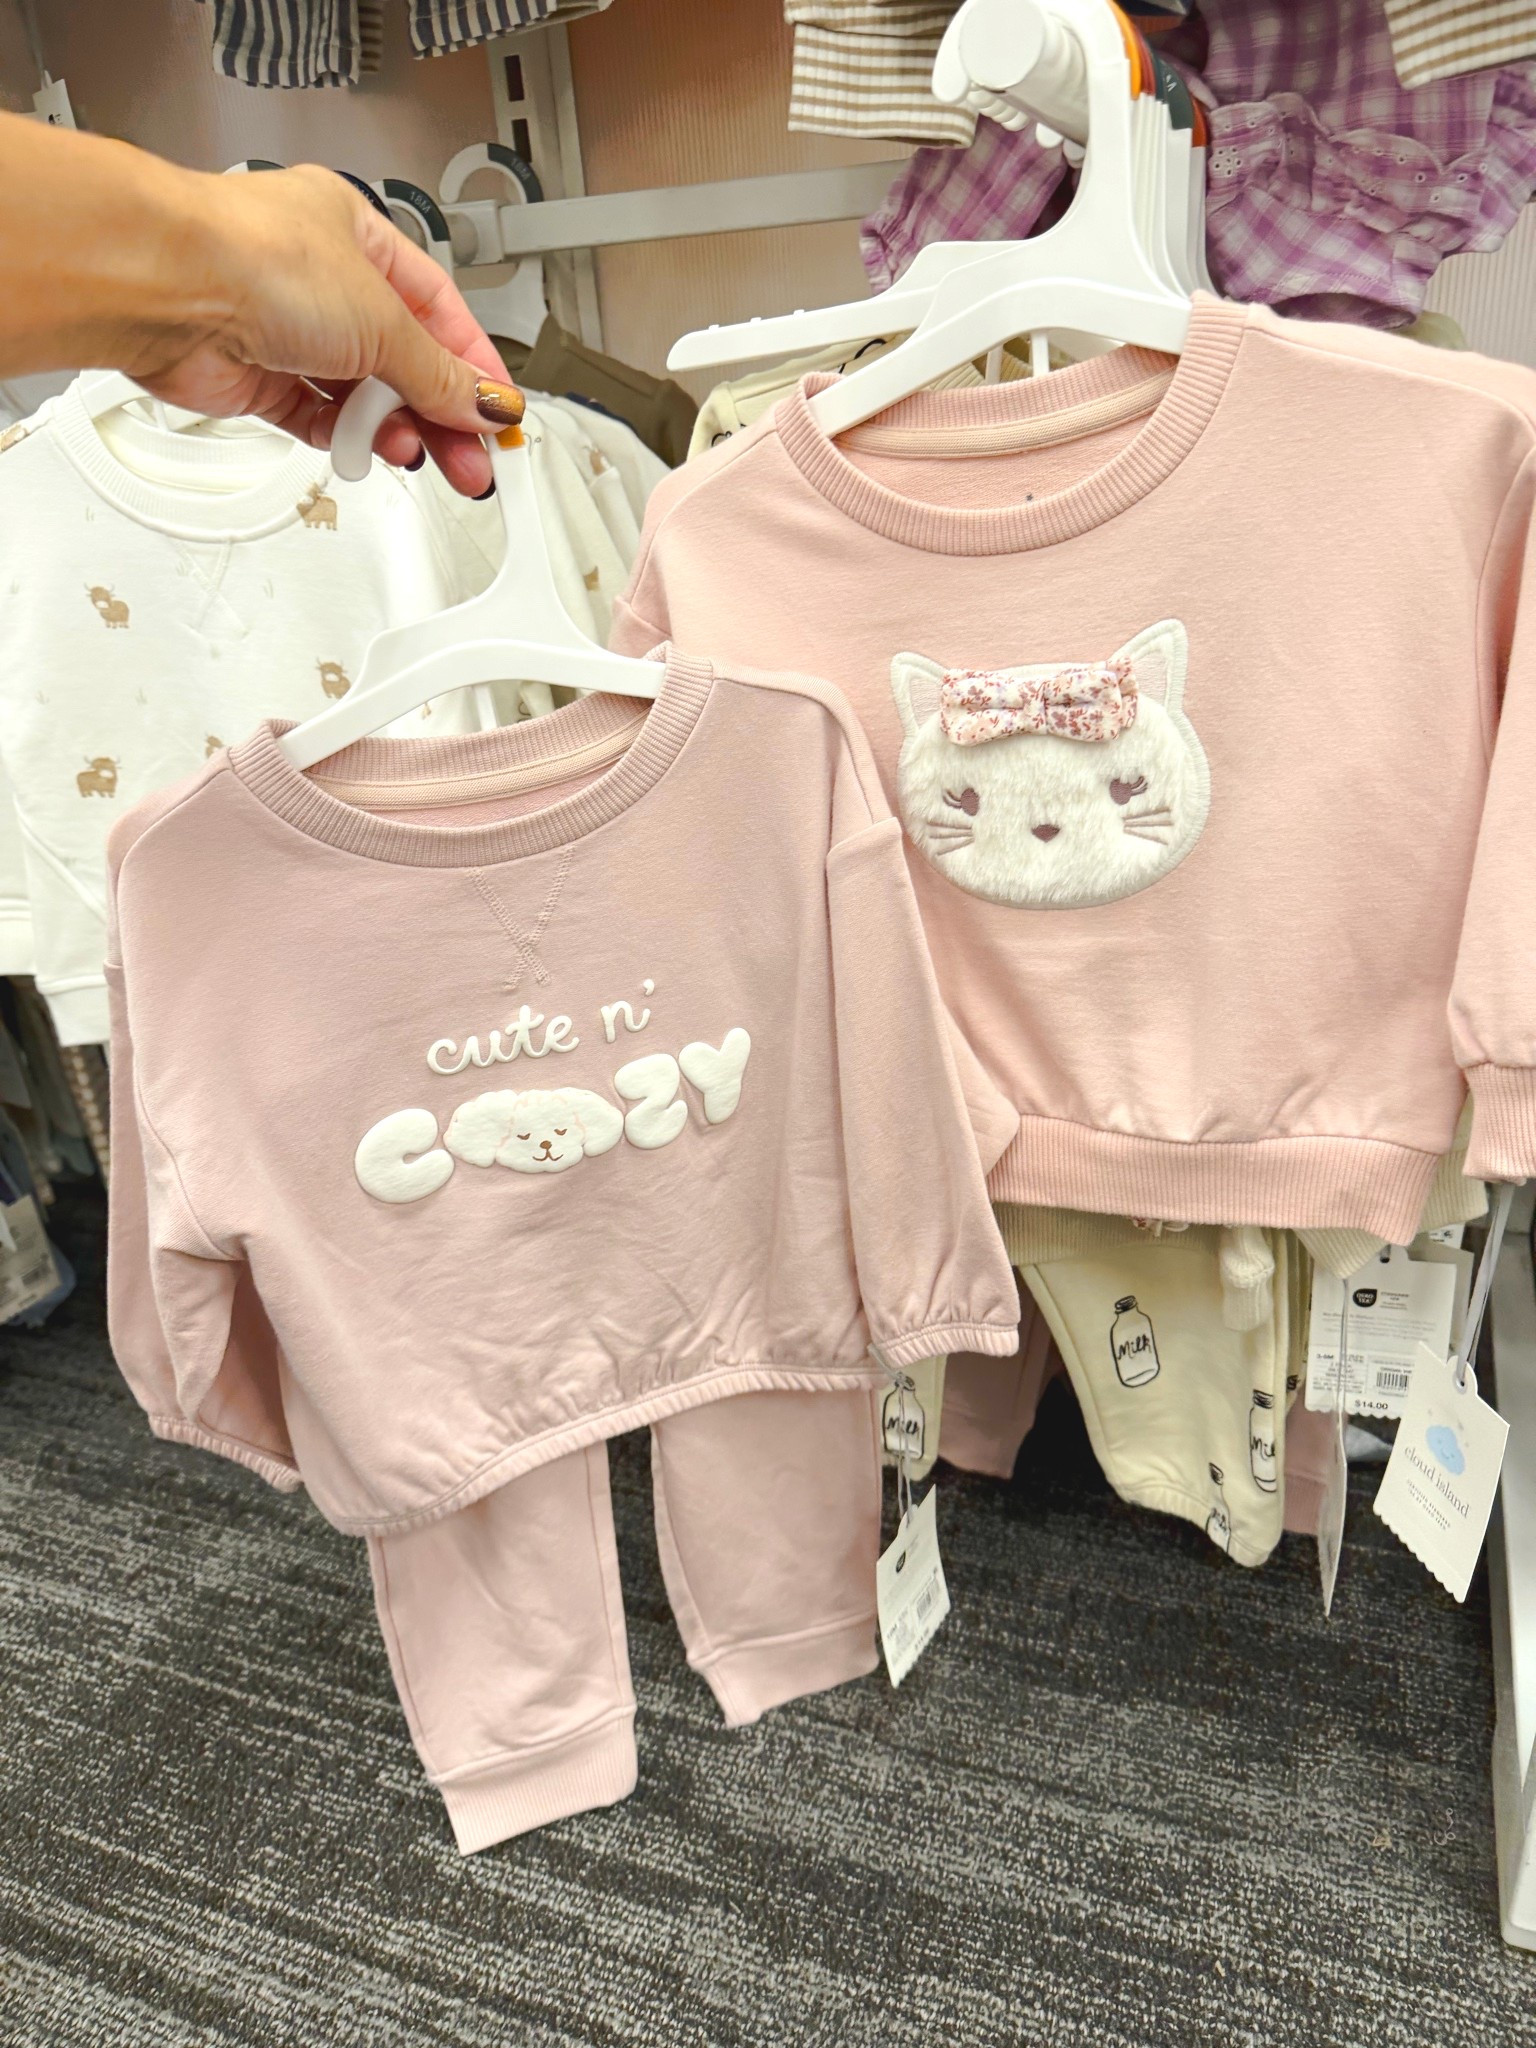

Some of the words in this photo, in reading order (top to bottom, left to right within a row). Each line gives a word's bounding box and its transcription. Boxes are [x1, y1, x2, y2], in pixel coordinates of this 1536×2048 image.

[409, 191, 432, 214] 18M
[426, 1004, 580, 1076] cute
[1116, 1333, 1152, 1361] Milk
[1354, 1399, 1389, 1411] $14.00
[1404, 1446, 1436, 1483] cloud
[1435, 1472, 1470, 1519] island
